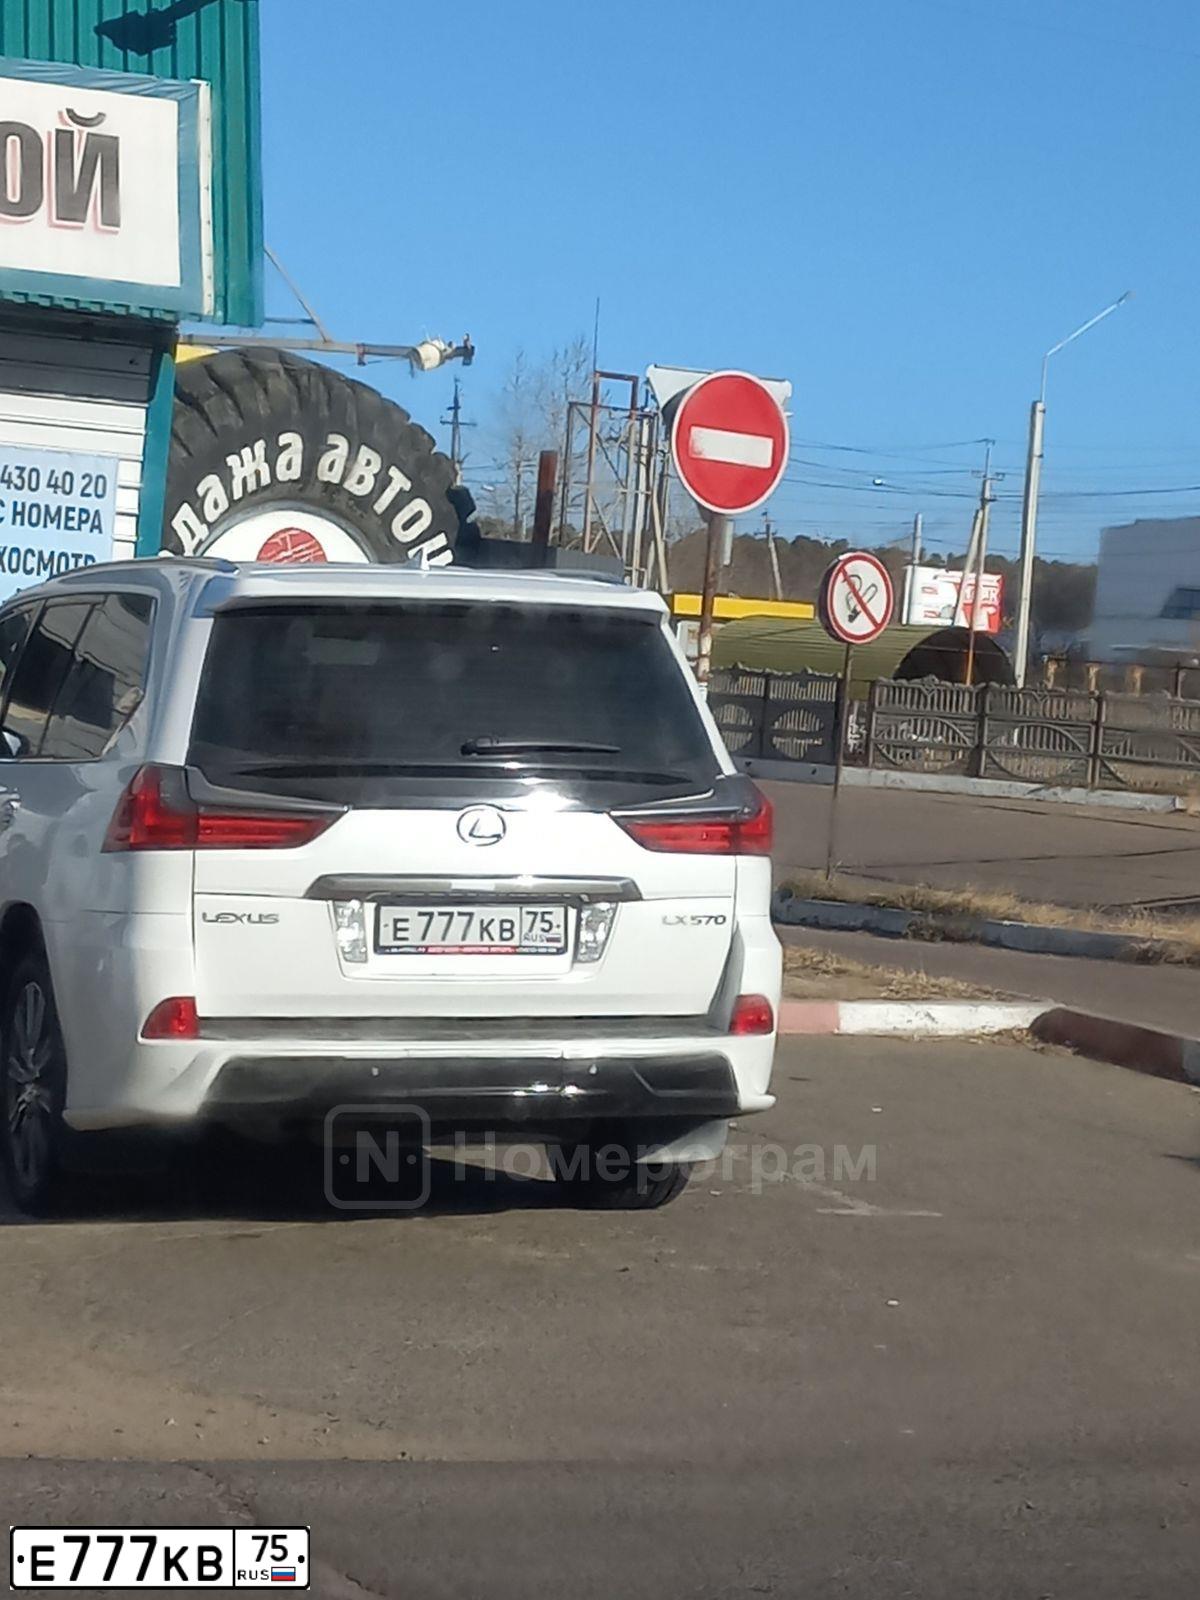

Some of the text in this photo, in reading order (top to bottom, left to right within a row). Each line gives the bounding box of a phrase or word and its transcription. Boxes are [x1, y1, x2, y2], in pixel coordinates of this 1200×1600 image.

[0, 464, 107, 499] 430 40 20
[158, 432, 303, 557] дажа
[11, 501, 103, 534] НОМЕРА
[202, 912, 279, 924] LEXUS
[525, 911, 553, 933] 75
[523, 933, 545, 943] RUS
